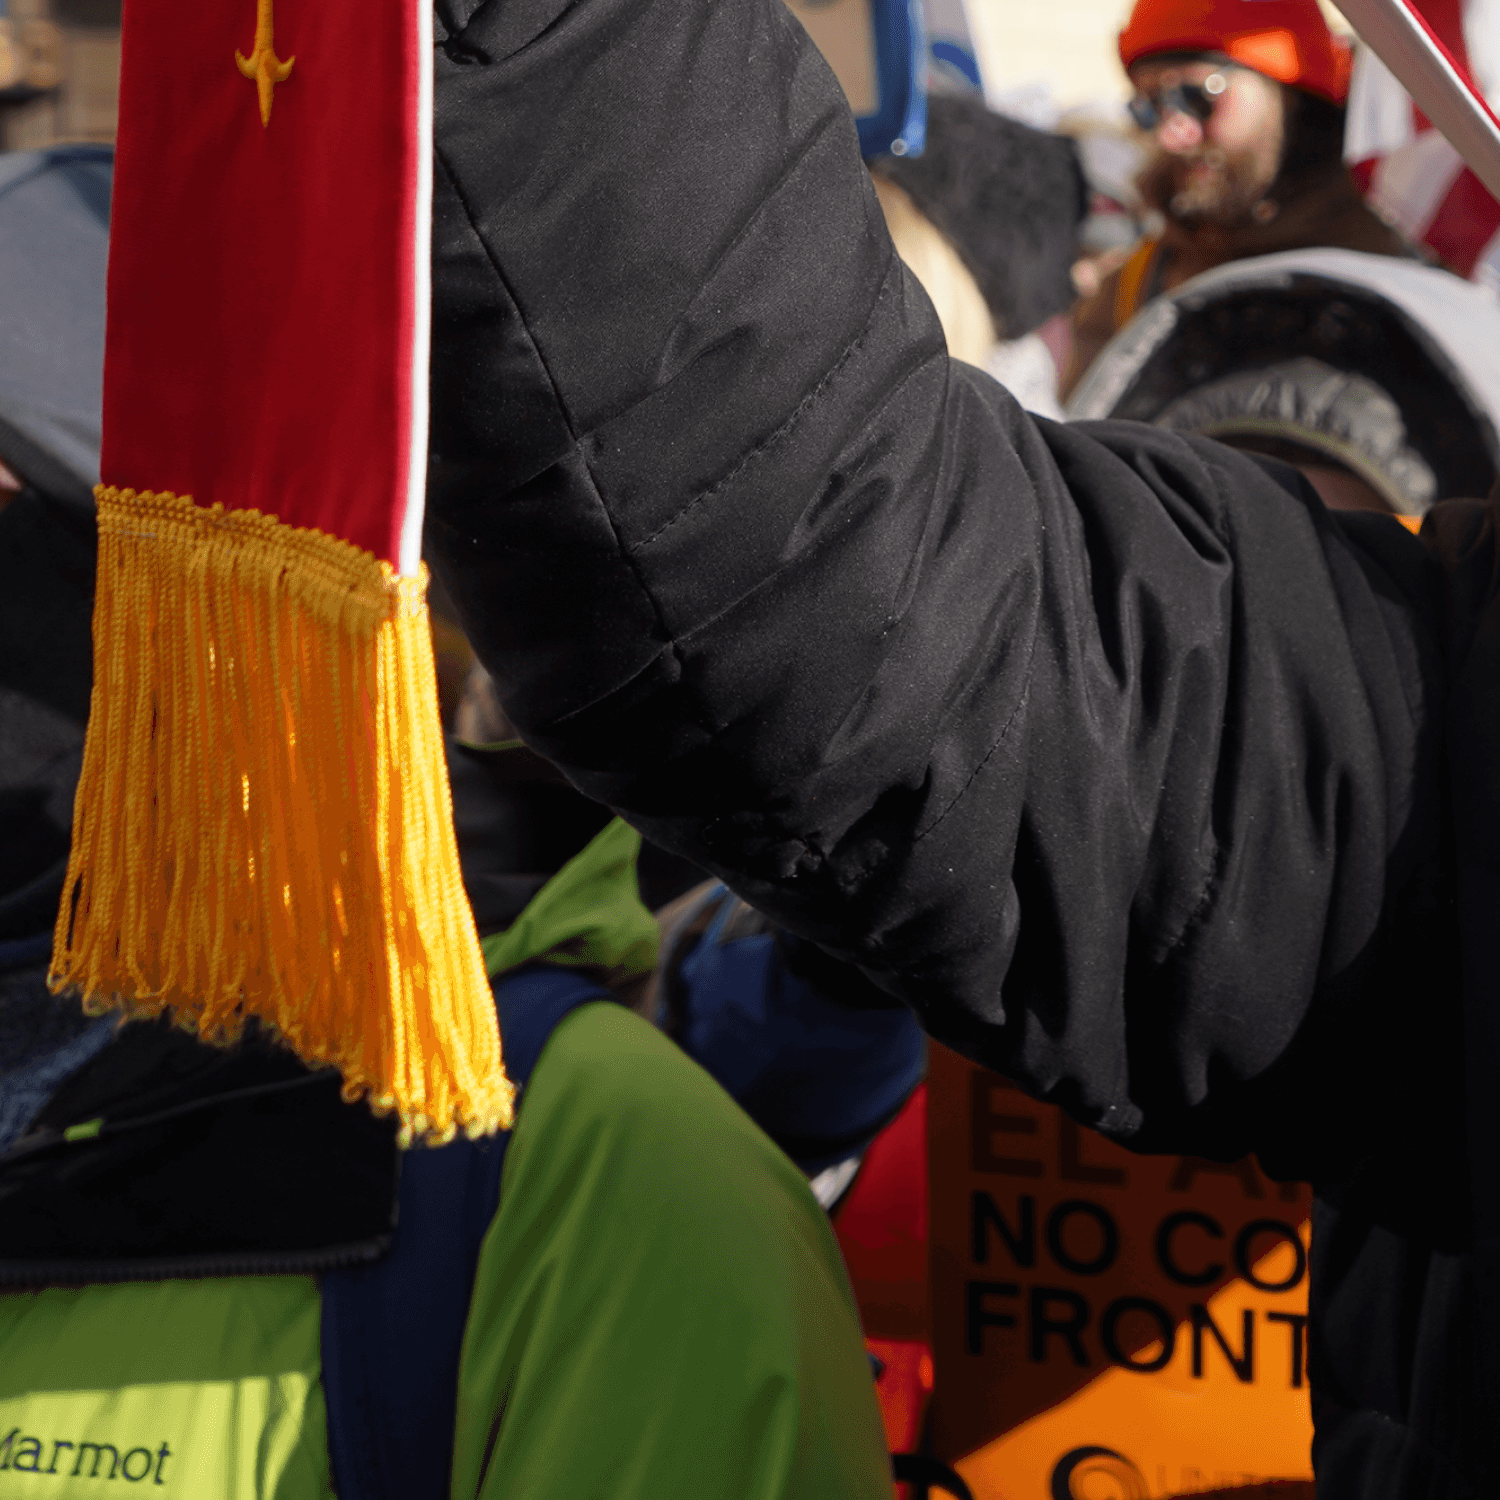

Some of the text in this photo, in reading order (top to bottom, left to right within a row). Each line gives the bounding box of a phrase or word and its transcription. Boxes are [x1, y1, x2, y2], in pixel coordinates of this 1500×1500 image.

[972, 1191, 1307, 1294] NO CO
[966, 1280, 1309, 1390] FRONT
